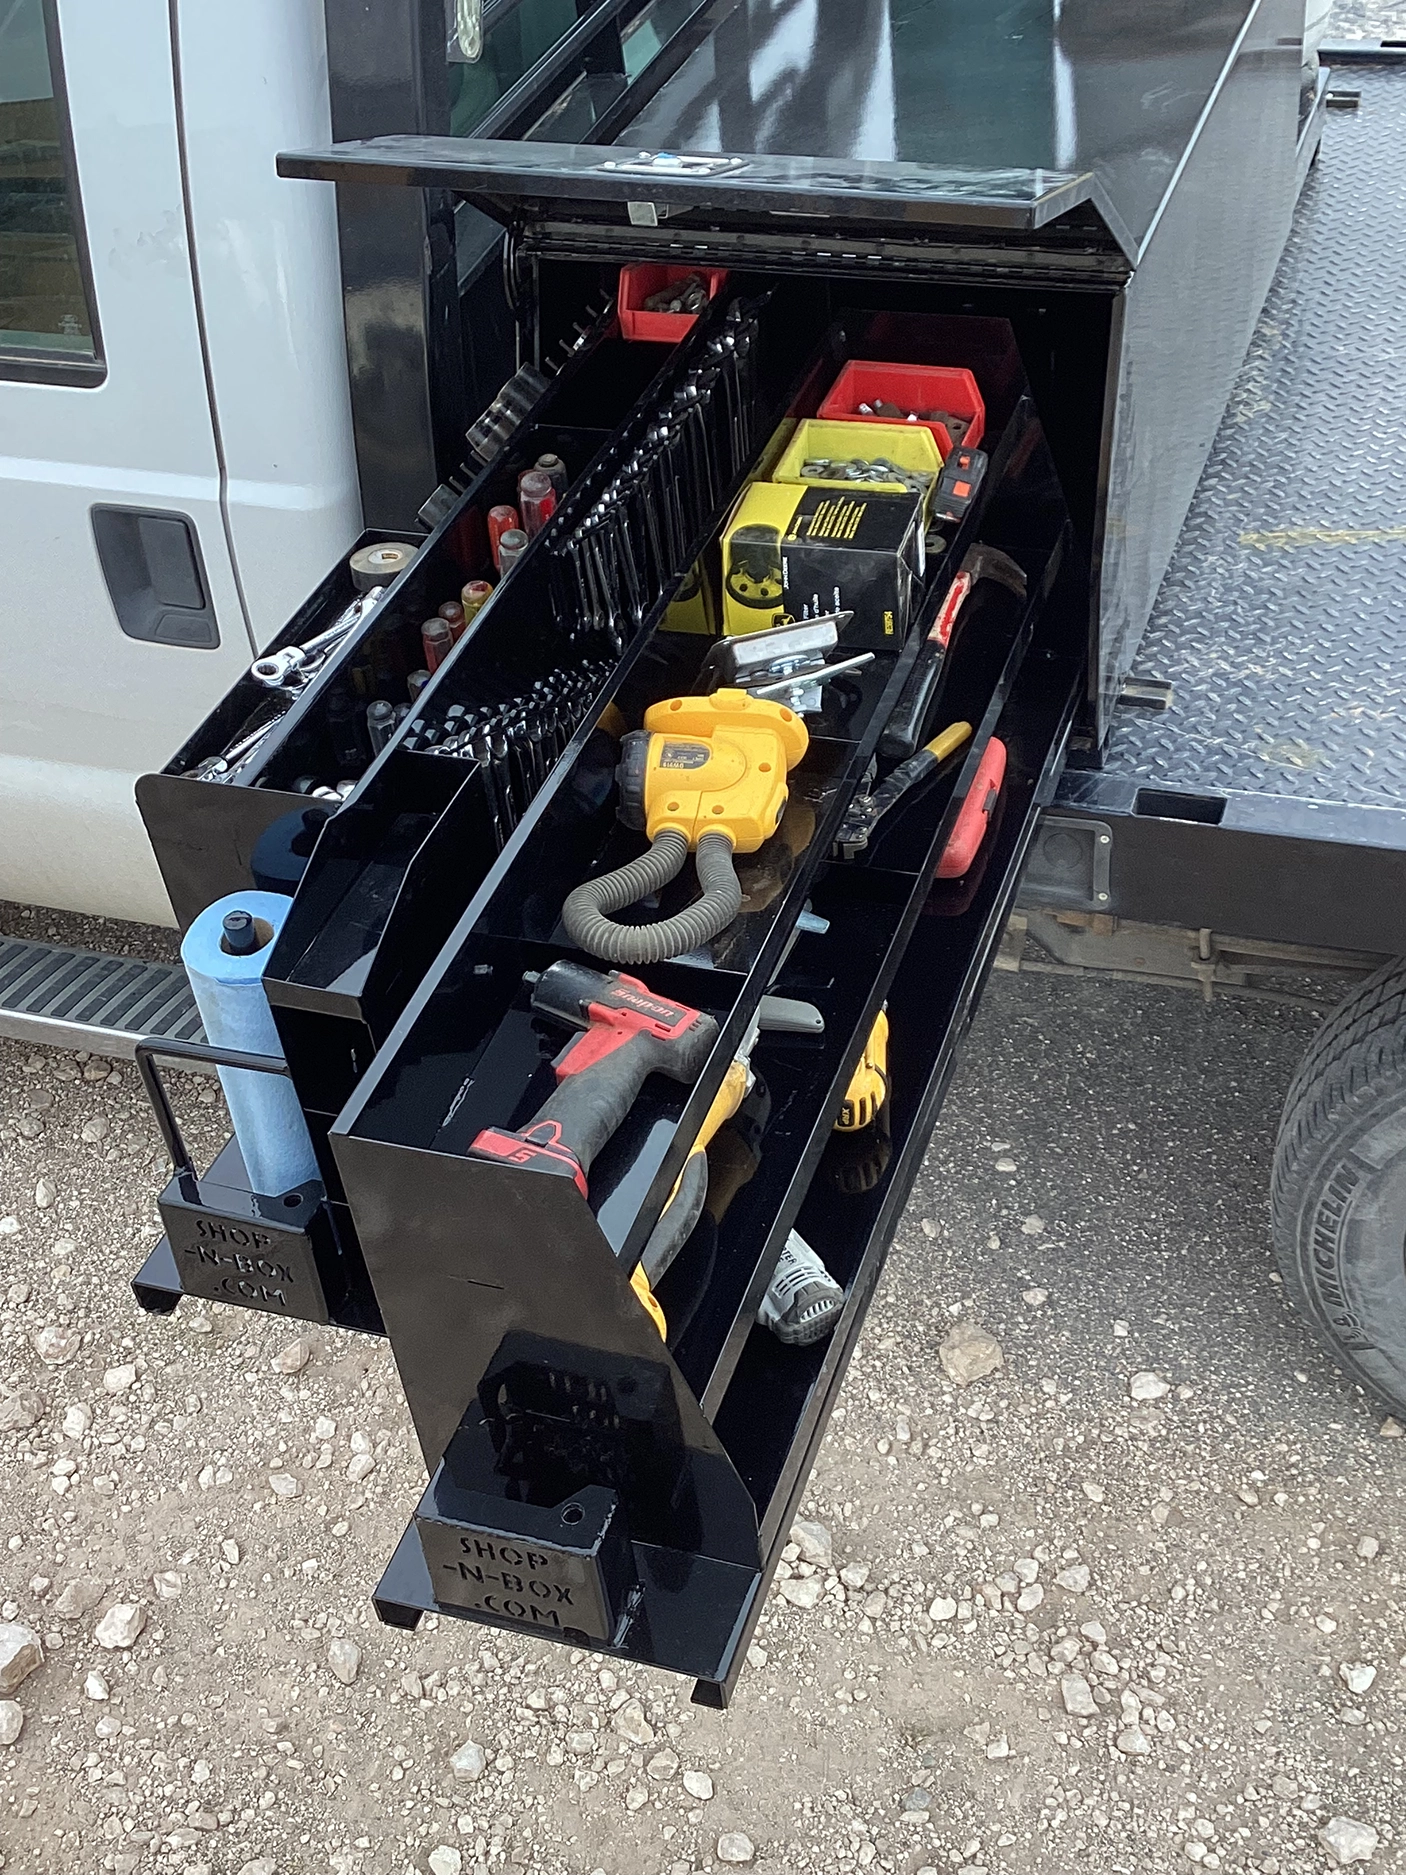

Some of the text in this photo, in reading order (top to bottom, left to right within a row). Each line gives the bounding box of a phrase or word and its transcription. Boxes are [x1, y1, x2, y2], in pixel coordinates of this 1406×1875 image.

[841, 1107, 850, 1125] XRP
[196, 1220, 271, 1249] SHOP
[1313, 1164, 1360, 1308] MICHELIN
[184, 1245, 294, 1283] -N-BOX
[213, 1278, 286, 1306] .COM
[460, 1537, 548, 1570] SHOP
[443, 1562, 573, 1605] -N-BOX
[474, 1595, 560, 1626] .COM
